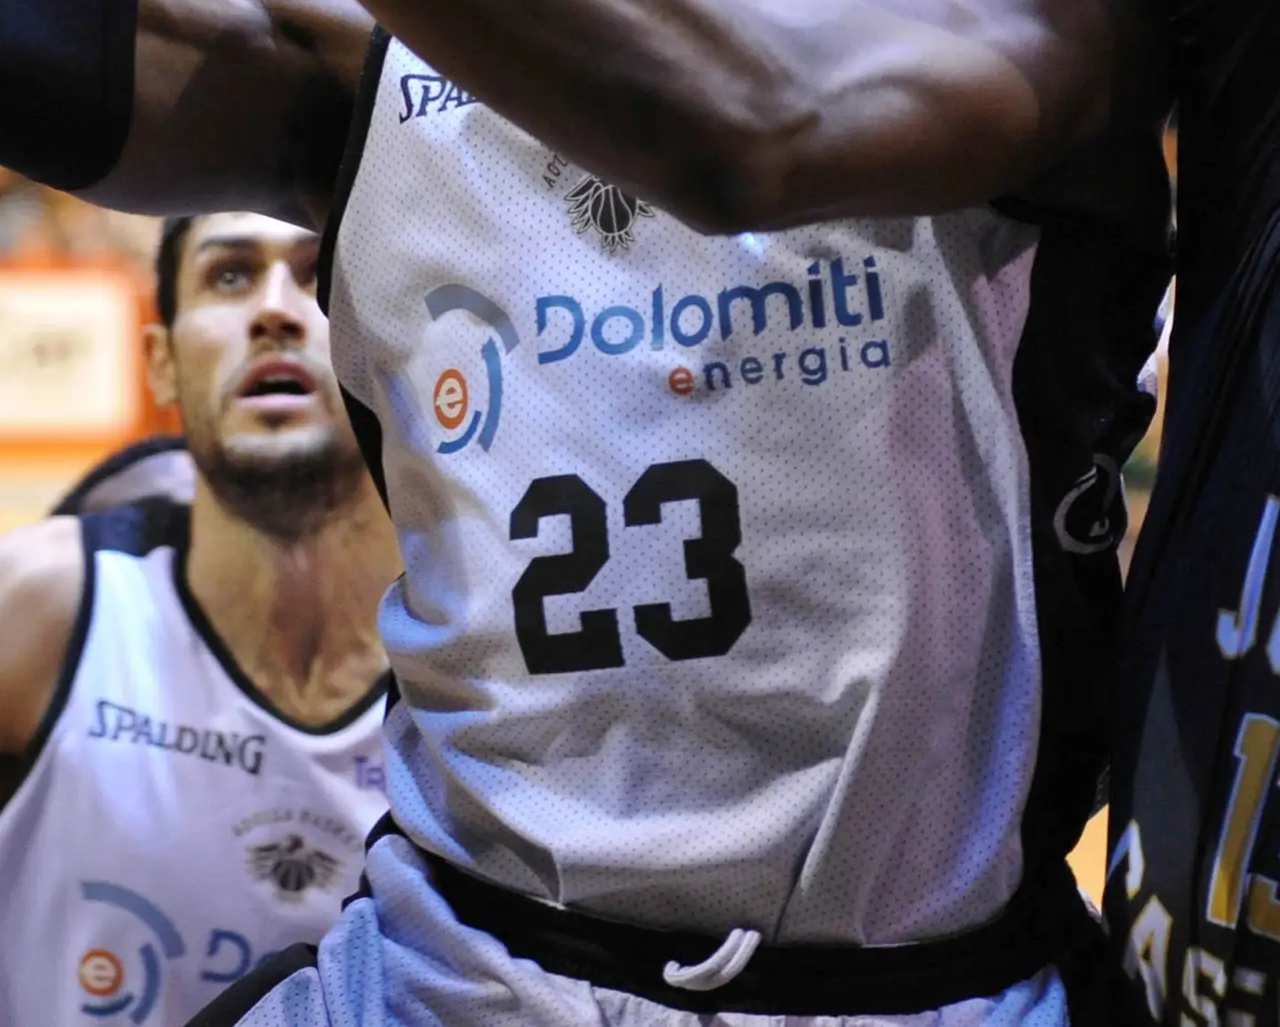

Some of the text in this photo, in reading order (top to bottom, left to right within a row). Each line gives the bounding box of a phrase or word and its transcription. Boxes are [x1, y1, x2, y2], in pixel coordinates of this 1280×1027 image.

[399, 74, 482, 124] SPA
[536, 255, 885, 364] Dolomiti
[668, 336, 891, 396] energia
[509, 459, 753, 675] 23
[88, 699, 267, 776] SPALDING
